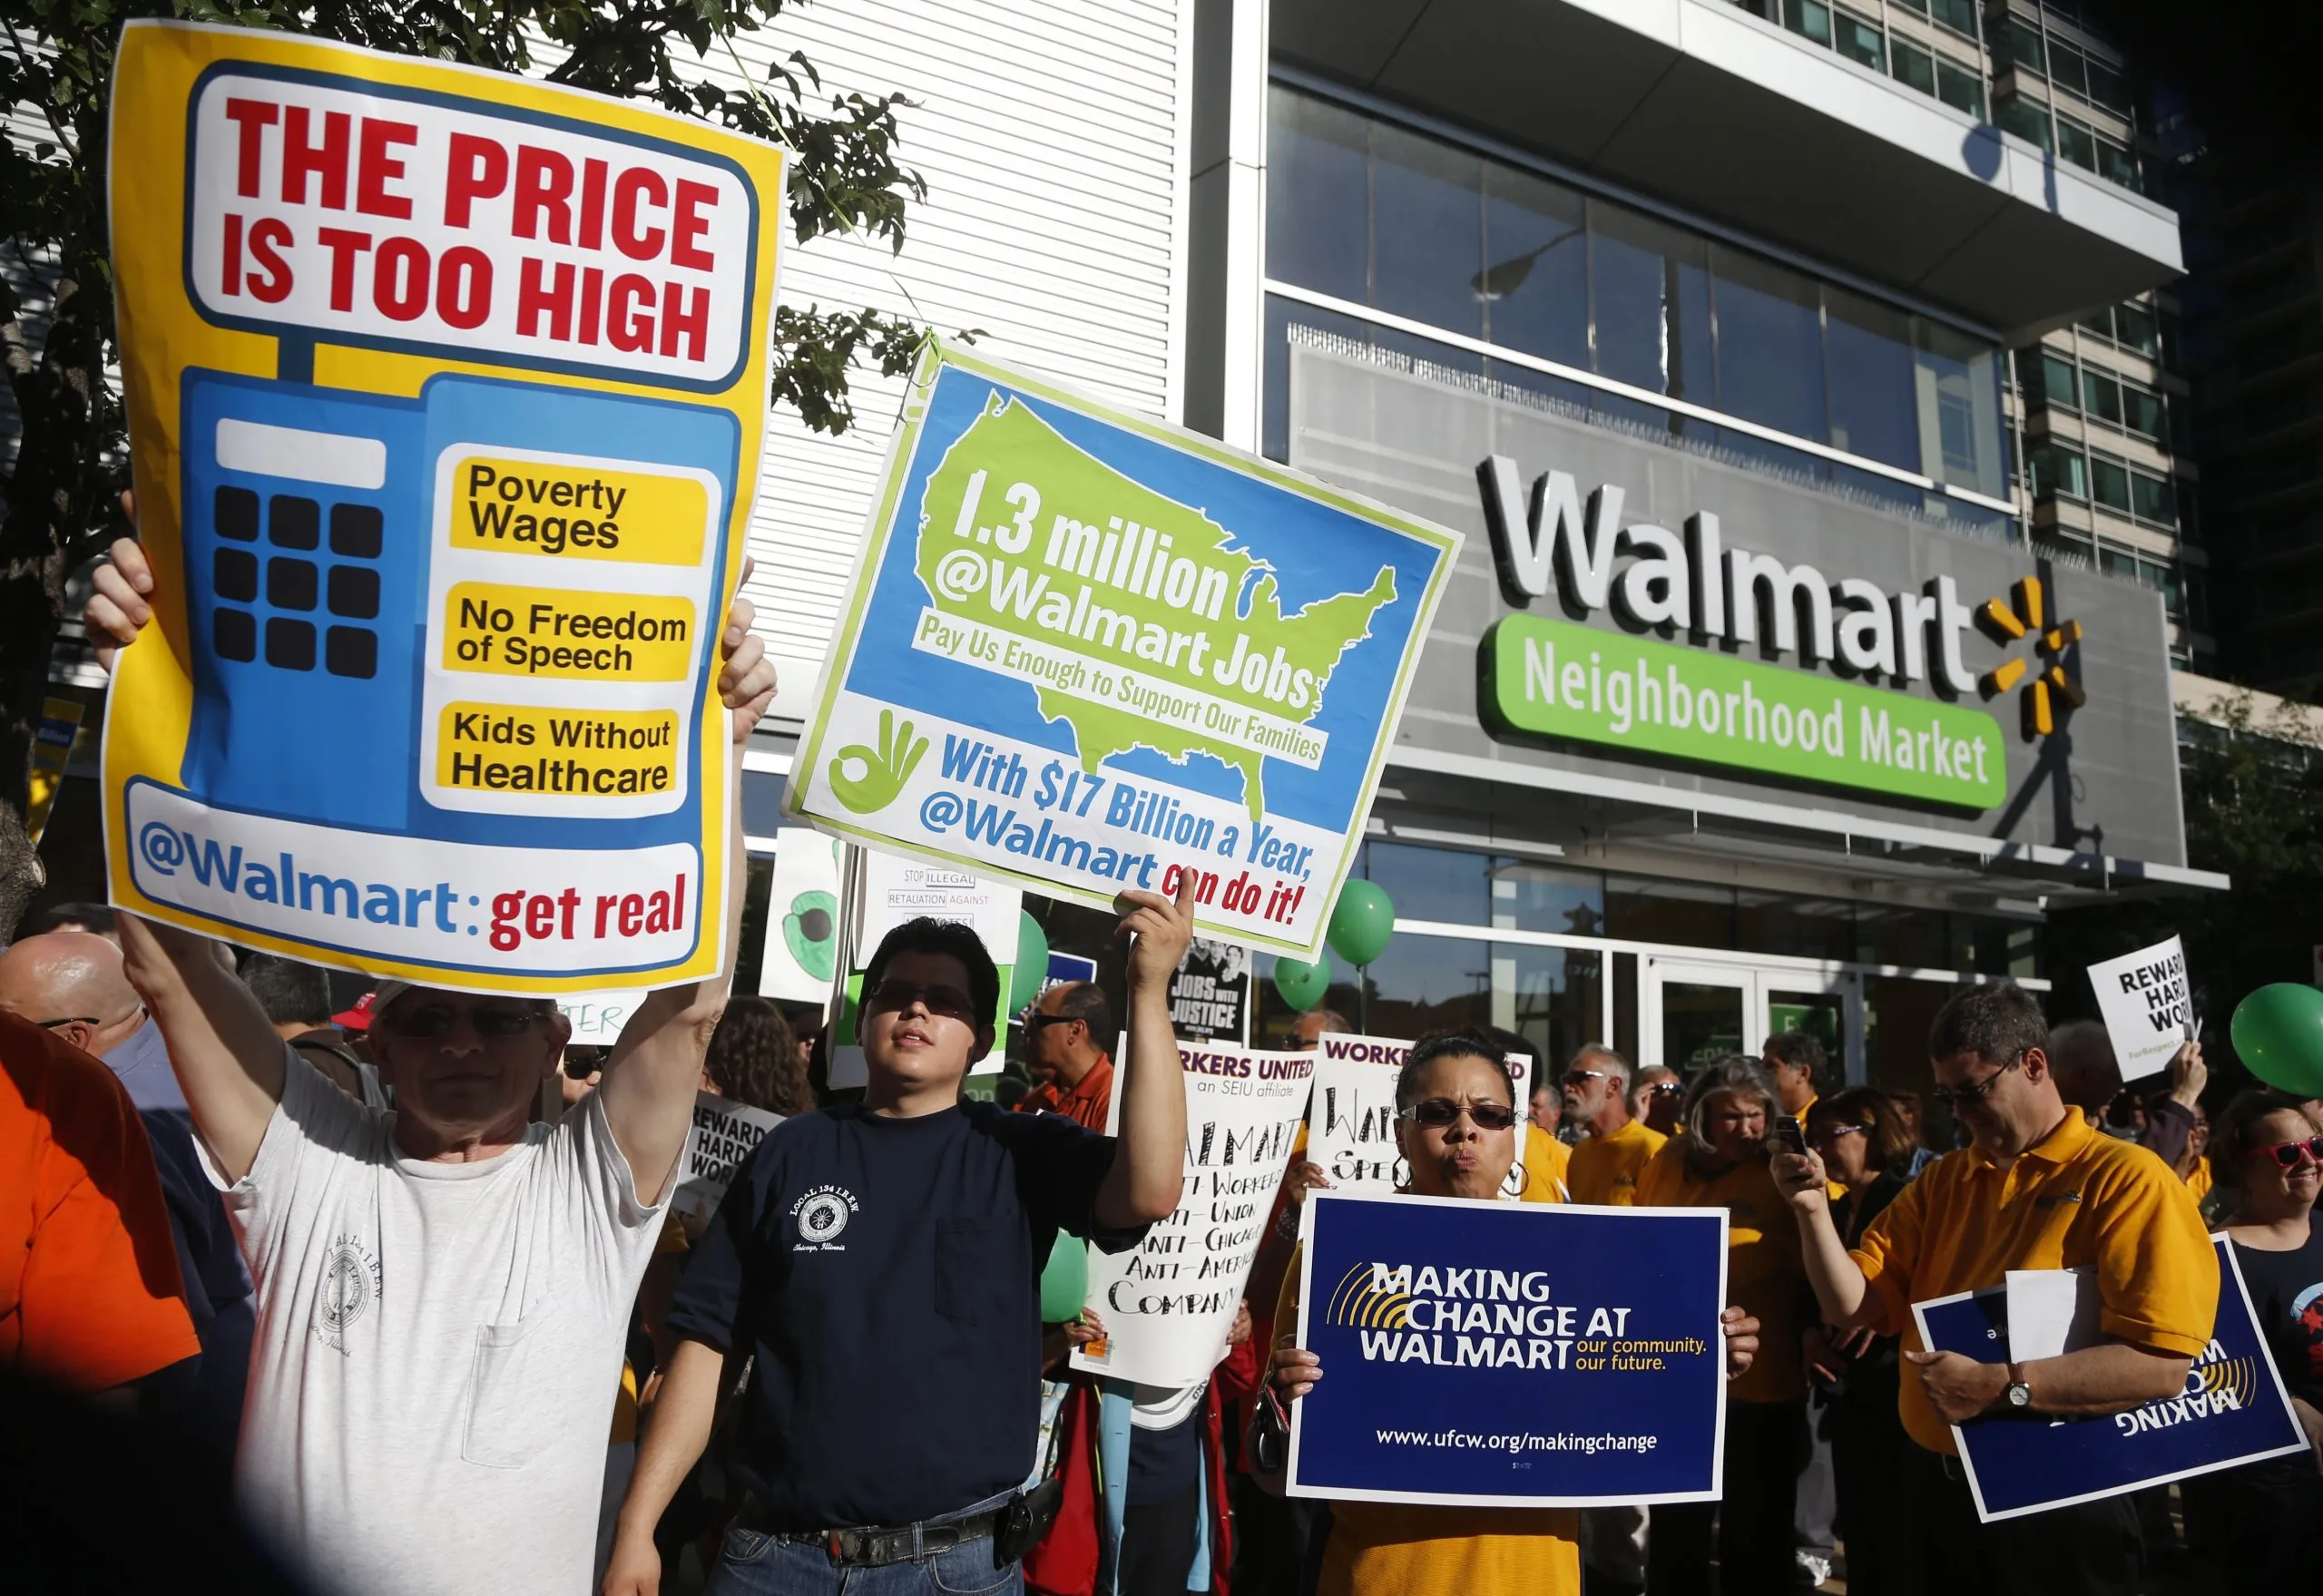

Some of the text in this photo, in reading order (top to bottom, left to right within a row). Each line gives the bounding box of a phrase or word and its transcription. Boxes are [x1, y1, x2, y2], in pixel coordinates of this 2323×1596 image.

[226, 96, 719, 272] THE PRICE
[221, 213, 711, 362] IS TOO HIGH
[468, 465, 626, 519] Poverty
[469, 501, 620, 553] Wages
[954, 469, 1229, 621] 1.3 million
[1475, 455, 1976, 699] Walmart
[459, 598, 686, 642] No Freedom
[935, 549, 1313, 710] @Walmart Jobs
[456, 634, 633, 671] of Speech
[920, 616, 1321, 761] Pay Us Enough to Support Our Families
[454, 712, 670, 749] Kids Without
[1524, 637, 1988, 785] Neighborhood Market
[453, 753, 668, 794] Healthcare
[941, 734, 1315, 884] With $17 Billion a Year,
[905, 870, 974, 884] STOP ILLEGAL
[919, 791, 1158, 892] @Walmart
[1221, 871, 1262, 915] do
[1264, 880, 1305, 925] it!
[489, 886, 582, 952] get
[594, 872, 685, 938] real
[889, 894, 989, 905] RETALIATION AGAINST
[1171, 974, 1239, 1004] JOBS WITH
[1170, 999, 1237, 1029] JUSTICE
[2148, 1001, 2191, 1033] WOR
[1180, 1051, 1314, 1080] RKERS UNITED
[1325, 1040, 1412, 1066] WORKE
[1197, 1081, 1294, 1098] an SEIU affiliate
[693, 1105, 766, 1147] REWARD
[1325, 1087, 1402, 1144] WAL
[697, 1131, 748, 1166] HARD
[1181, 1118, 1300, 1167] LMART
[691, 1152, 733, 1185] WOR
[1331, 1150, 1411, 1183] SPEN
[789, 1188, 817, 1217] LOCAL
[818, 1184, 835, 1193] 134
[820, 1242, 846, 1251] Illinois
[1108, 1280, 1237, 1315] COMPANY
[1370, 1262, 1550, 1302] MAKING
[1405, 1298, 1632, 1337] CHANGE AT
[1360, 1329, 1707, 1371] WALMART our community.
[1575, 1354, 1666, 1371] our future.
[2115, 1387, 2242, 1436] MAKING
[1377, 1428, 1657, 1454] www.ufcw.org/makingchange
